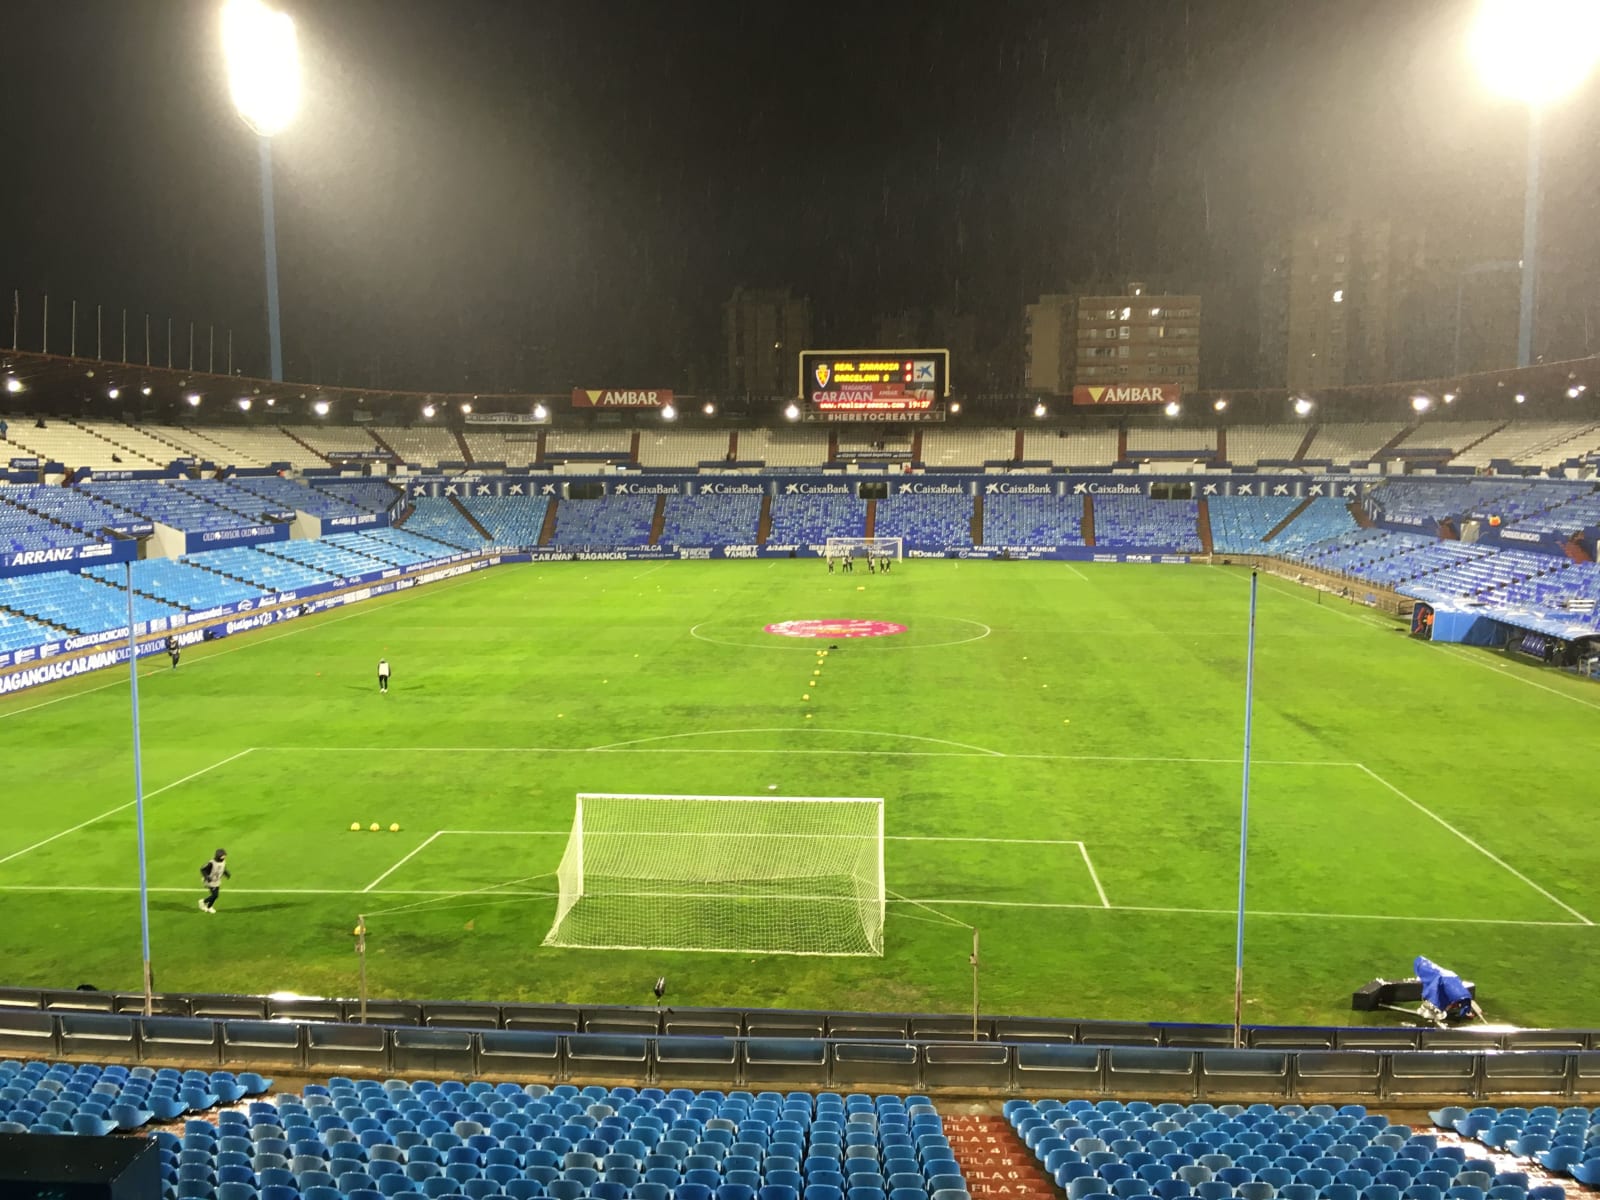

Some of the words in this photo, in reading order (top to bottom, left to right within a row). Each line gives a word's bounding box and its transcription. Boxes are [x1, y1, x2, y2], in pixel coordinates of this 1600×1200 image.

[834, 363, 855, 371] REAL
[859, 363, 899, 371] ZARAGOZA
[834, 374, 880, 382] BARCELONA
[604, 391, 661, 406] AMBAR
[813, 391, 873, 402] CARAVAN
[1105, 387, 1164, 402] AMBAR
[828, 413, 920, 421] #HERETOCREATE
[629, 483, 679, 494] CaixaBank
[715, 483, 764, 494] CaixaBank
[799, 483, 849, 494] CaixaBank
[913, 483, 964, 494] CaixaBank
[1000, 483, 1052, 494] CaixaBank
[1088, 483, 1141, 494] CaixaBank
[12, 547, 74, 566] ARRANZ
[532, 553, 574, 561] CARAVAN
[178, 629, 204, 648] AMBAR
[116, 647, 132, 661] OLD
[140, 639, 166, 655] TAYLOR
[62, 649, 117, 677] CARAVAN
[944, 1124, 976, 1132] FILA
[979, 1125, 988, 1133] 2
[948, 1135, 980, 1143] FILA
[961, 1157, 995, 1165] FILA
[967, 1171, 1005, 1180] FILA
[1008, 1171, 1018, 1180] 6
[972, 1184, 1010, 1193] FILA
[1016, 1185, 1027, 1194] 7
